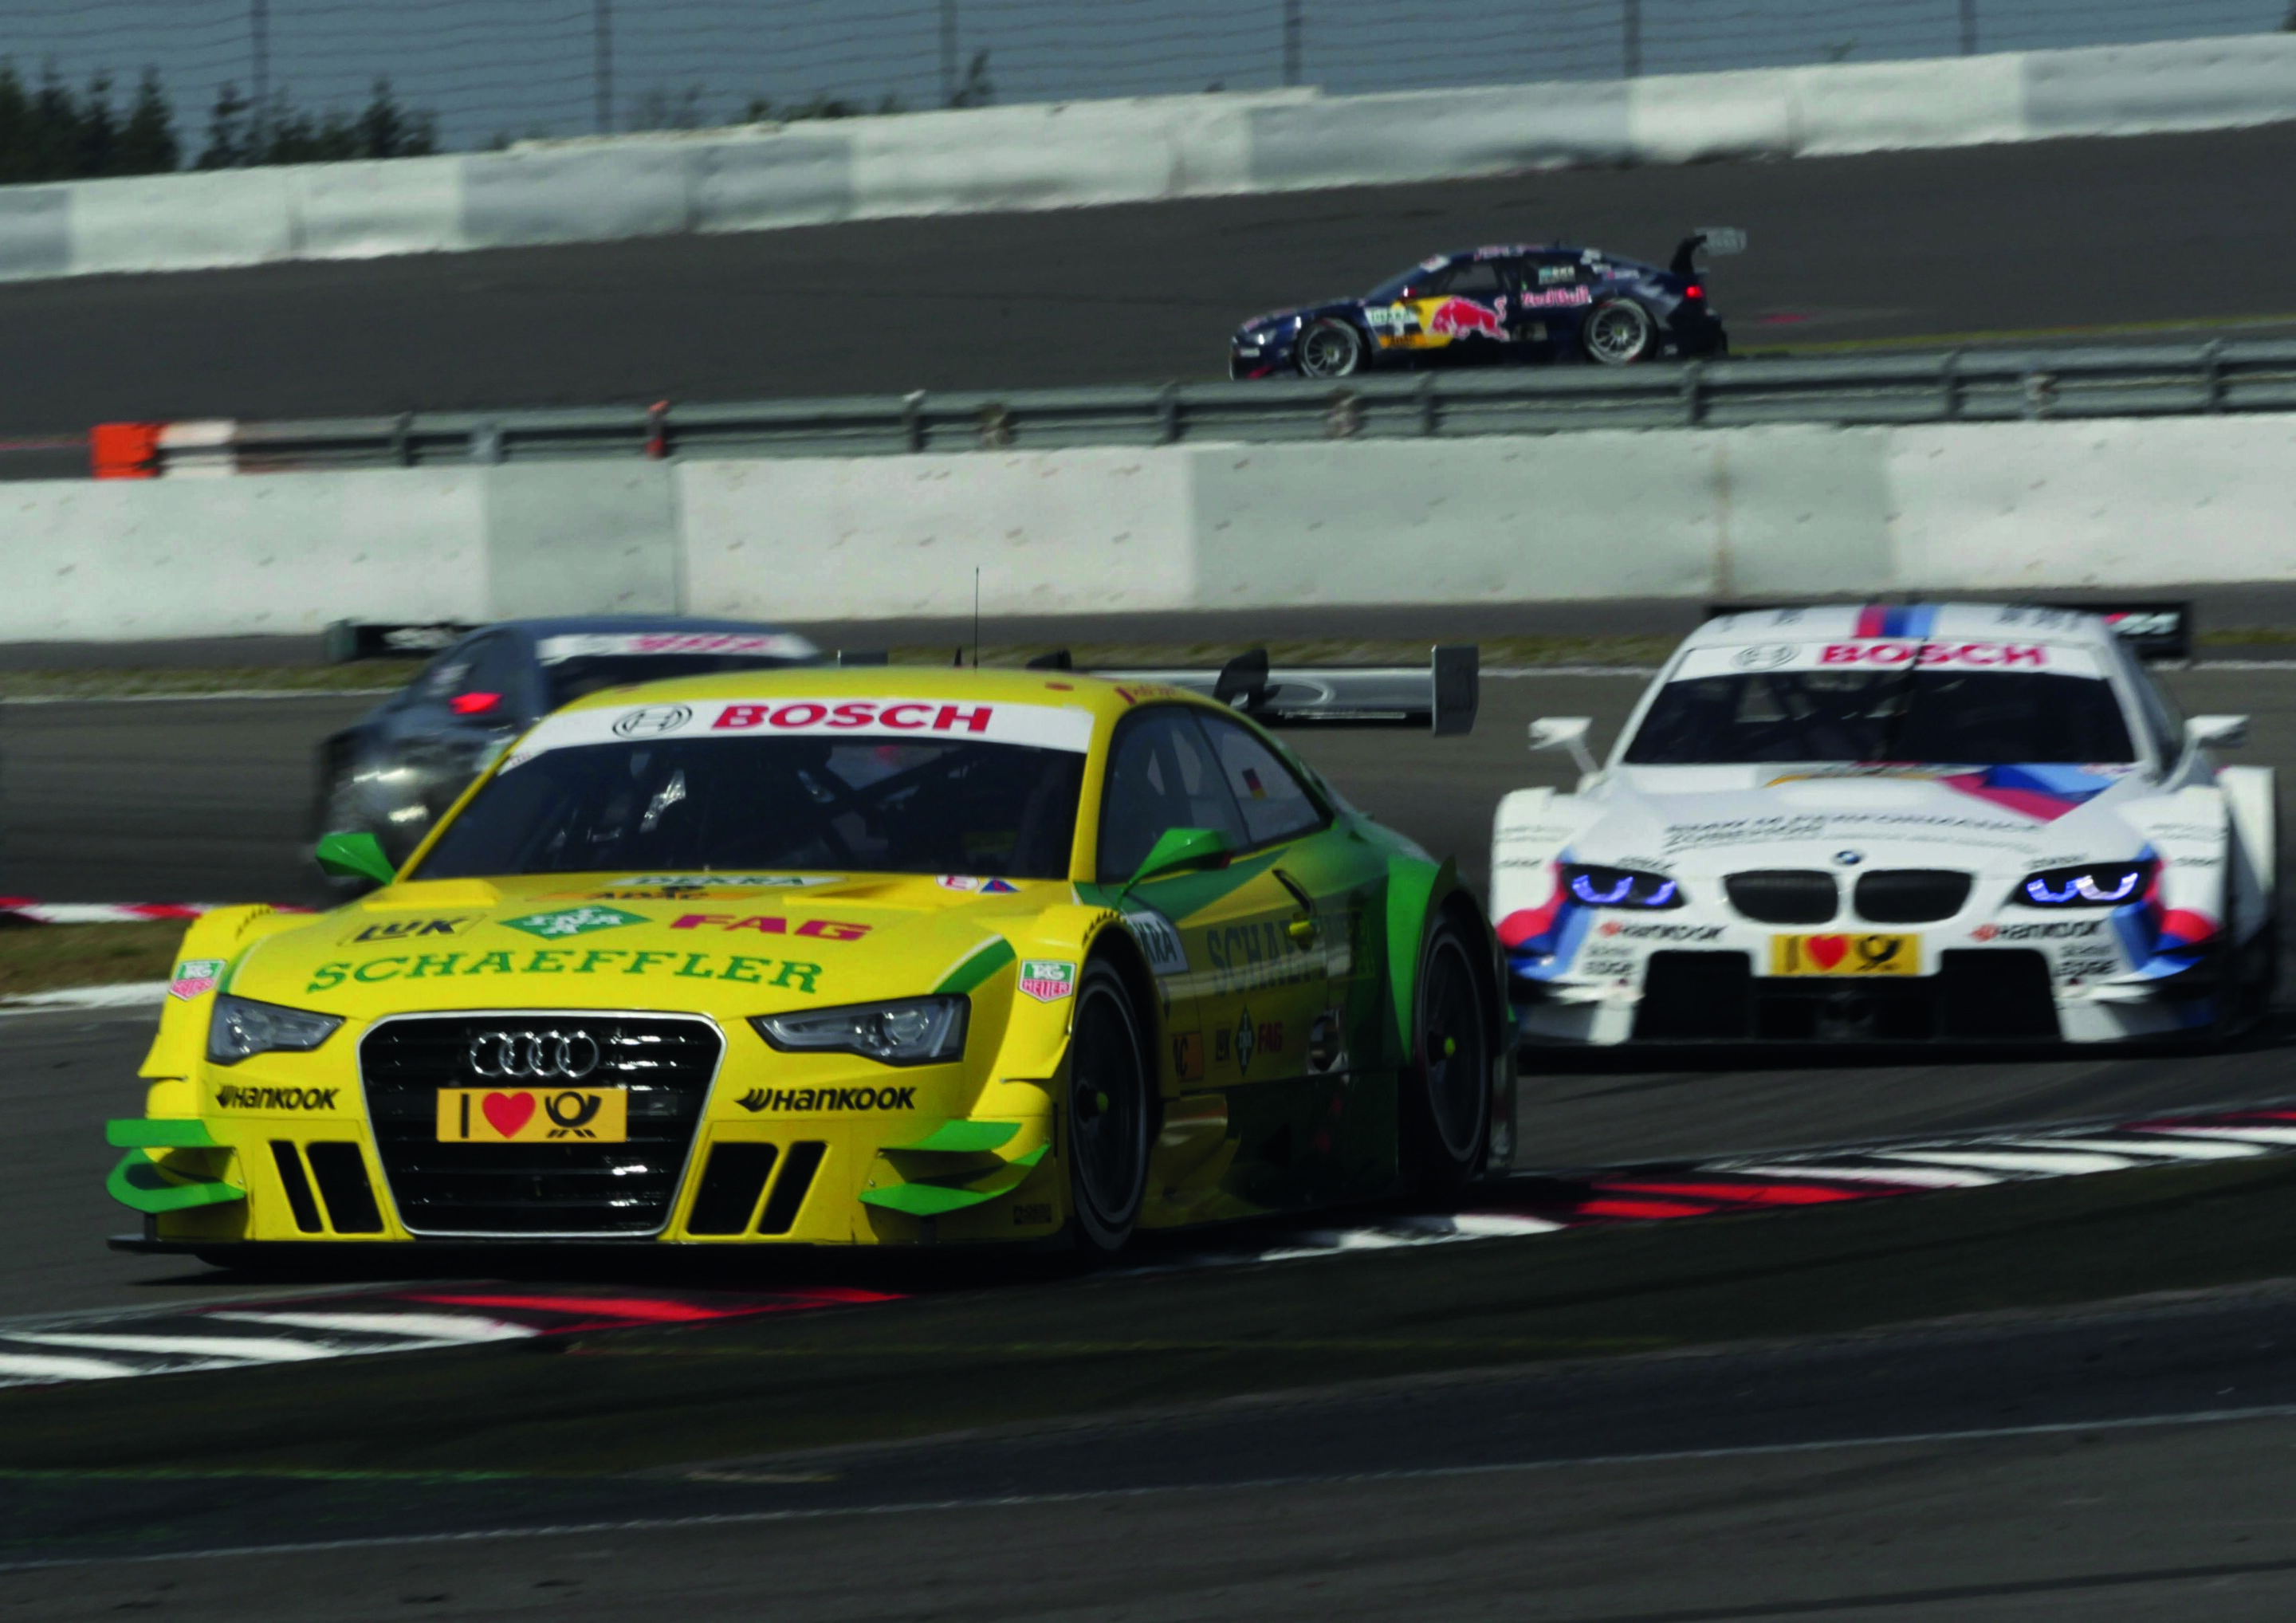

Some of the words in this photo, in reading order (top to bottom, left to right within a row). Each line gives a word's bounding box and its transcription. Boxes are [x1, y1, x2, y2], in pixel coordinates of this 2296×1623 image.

[1818, 643, 2048, 666] BOSCH
[710, 702, 993, 734] BOSCH
[670, 914, 872, 941] FAG
[1786, 935, 1800, 973] I
[305, 949, 823, 994] SCHAEFFLER
[1031, 963, 1065, 980] TAG
[1022, 979, 1071, 1000] HEUER
[1257, 1021, 1283, 1054] FAG
[460, 1093, 470, 1138] I
